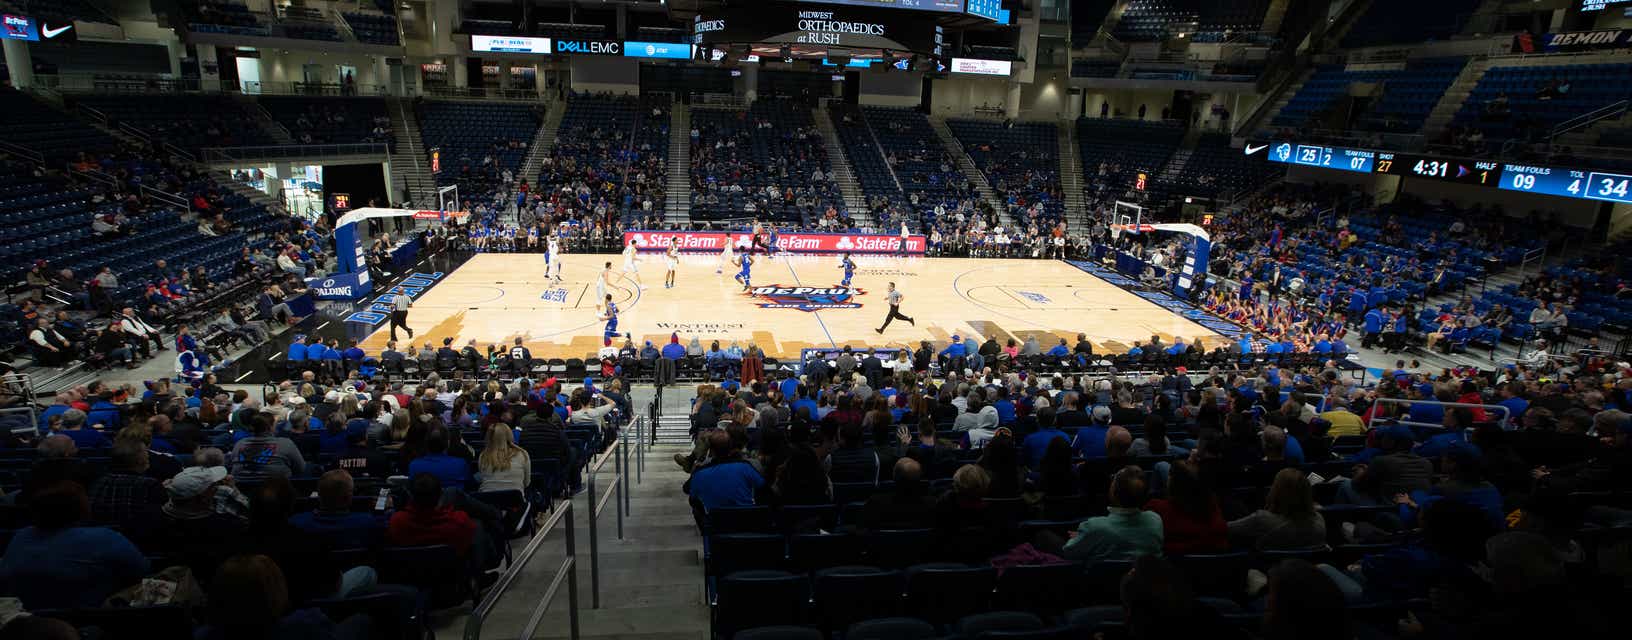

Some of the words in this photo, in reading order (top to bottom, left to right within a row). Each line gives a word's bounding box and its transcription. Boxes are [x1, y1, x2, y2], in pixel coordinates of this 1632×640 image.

[798, 10, 833, 20] MIDWEST
[798, 20, 884, 35] ORTHOPAEDICS
[808, 32, 840, 44] RUSH
[1548, 31, 1622, 46] DEMON
[1302, 149, 1316, 162] 25
[1324, 154, 1332, 166] 2
[1350, 157, 1366, 170] 07
[1377, 160, 1392, 172] 27
[1413, 159, 1448, 177] 4:31
[1476, 161, 1496, 170] HALF
[1504, 164, 1525, 174] TEAM
[1525, 166, 1550, 176] FOULS
[1480, 171, 1488, 184] 1
[1570, 170, 1584, 178] TOL
[1513, 174, 1535, 190] 09
[1567, 180, 1580, 195] 4
[1598, 178, 1628, 198] 34
